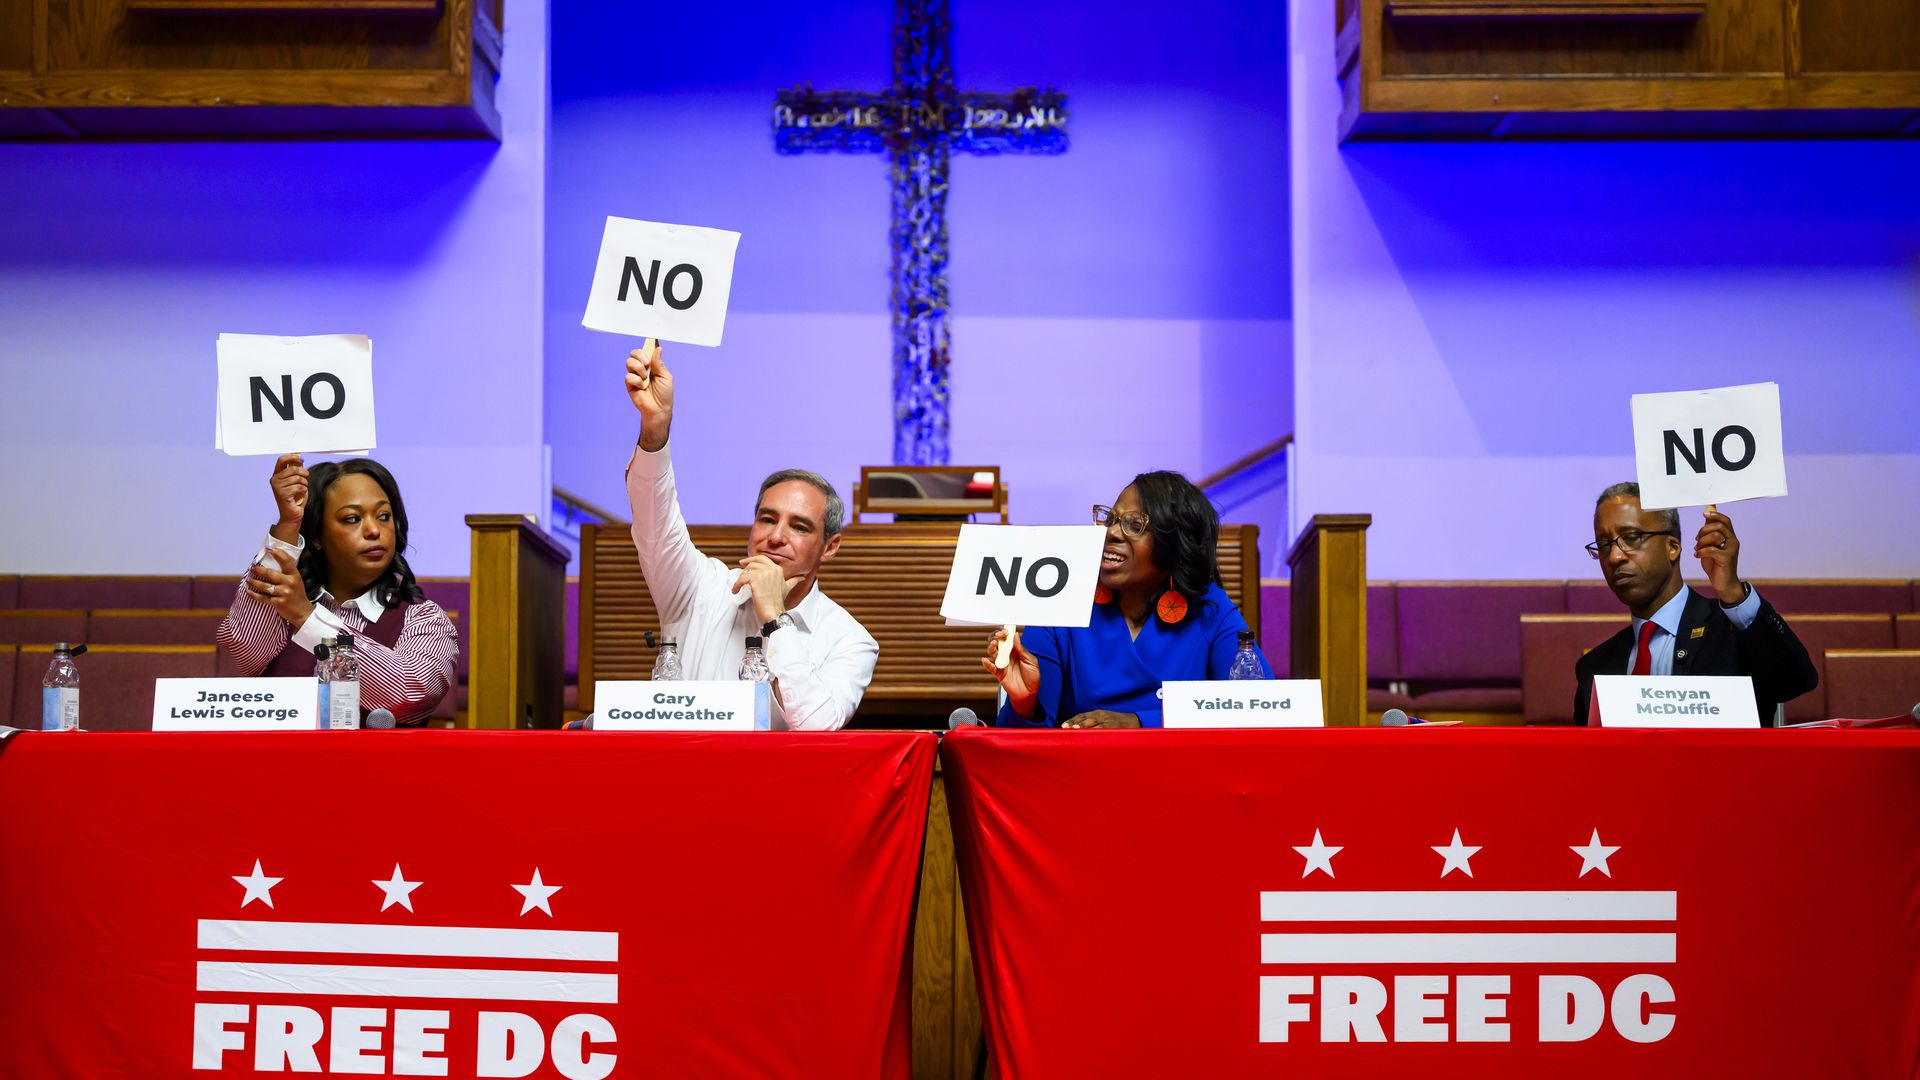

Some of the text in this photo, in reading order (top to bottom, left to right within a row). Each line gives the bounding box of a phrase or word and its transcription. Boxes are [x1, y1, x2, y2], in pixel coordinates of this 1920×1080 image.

[617, 255, 704, 311] NO
[249, 372, 346, 423] NO
[1663, 424, 1757, 477] NO
[976, 556, 1070, 598] NO
[196, 691, 274, 703] Janeese
[652, 692, 696, 707] Gary
[1640, 687, 1711, 702] Kenyan
[1193, 698, 1291, 710] Yaida Ford
[1636, 702, 1720, 716] McDuffie
[170, 706, 299, 721] Lewis George
[607, 707, 735, 721] Goodweather
[1259, 973, 1676, 1043] FREE DC
[193, 1003, 619, 1080] FREE DC
